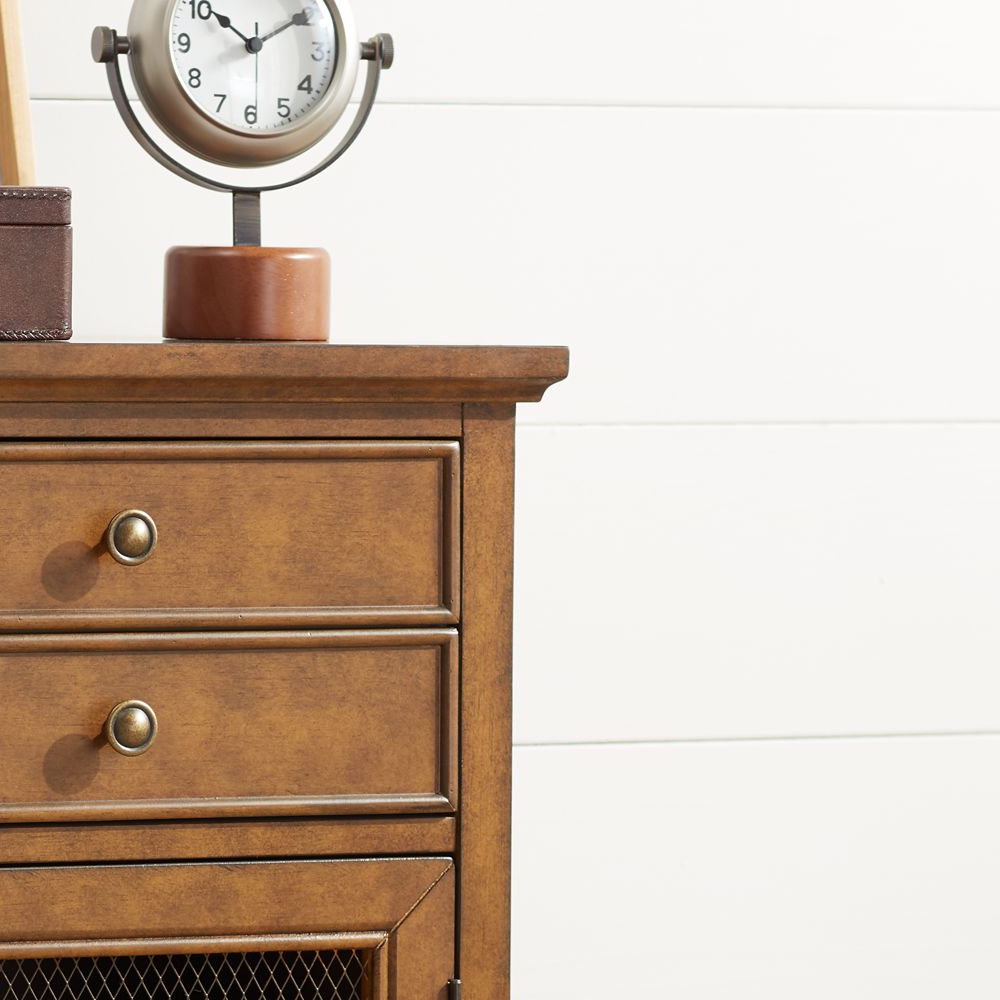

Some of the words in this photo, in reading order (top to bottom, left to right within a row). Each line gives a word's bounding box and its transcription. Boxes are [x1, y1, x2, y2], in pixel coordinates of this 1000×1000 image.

[190, 0, 211, 20] 10
[178, 33, 191, 53] 9
[311, 42, 325, 61] 3
[188, 68, 201, 88] 8
[297, 75, 313, 94] 4
[213, 94, 227, 113] 7
[277, 98, 291, 118] 5
[244, 105, 257, 124] 6
